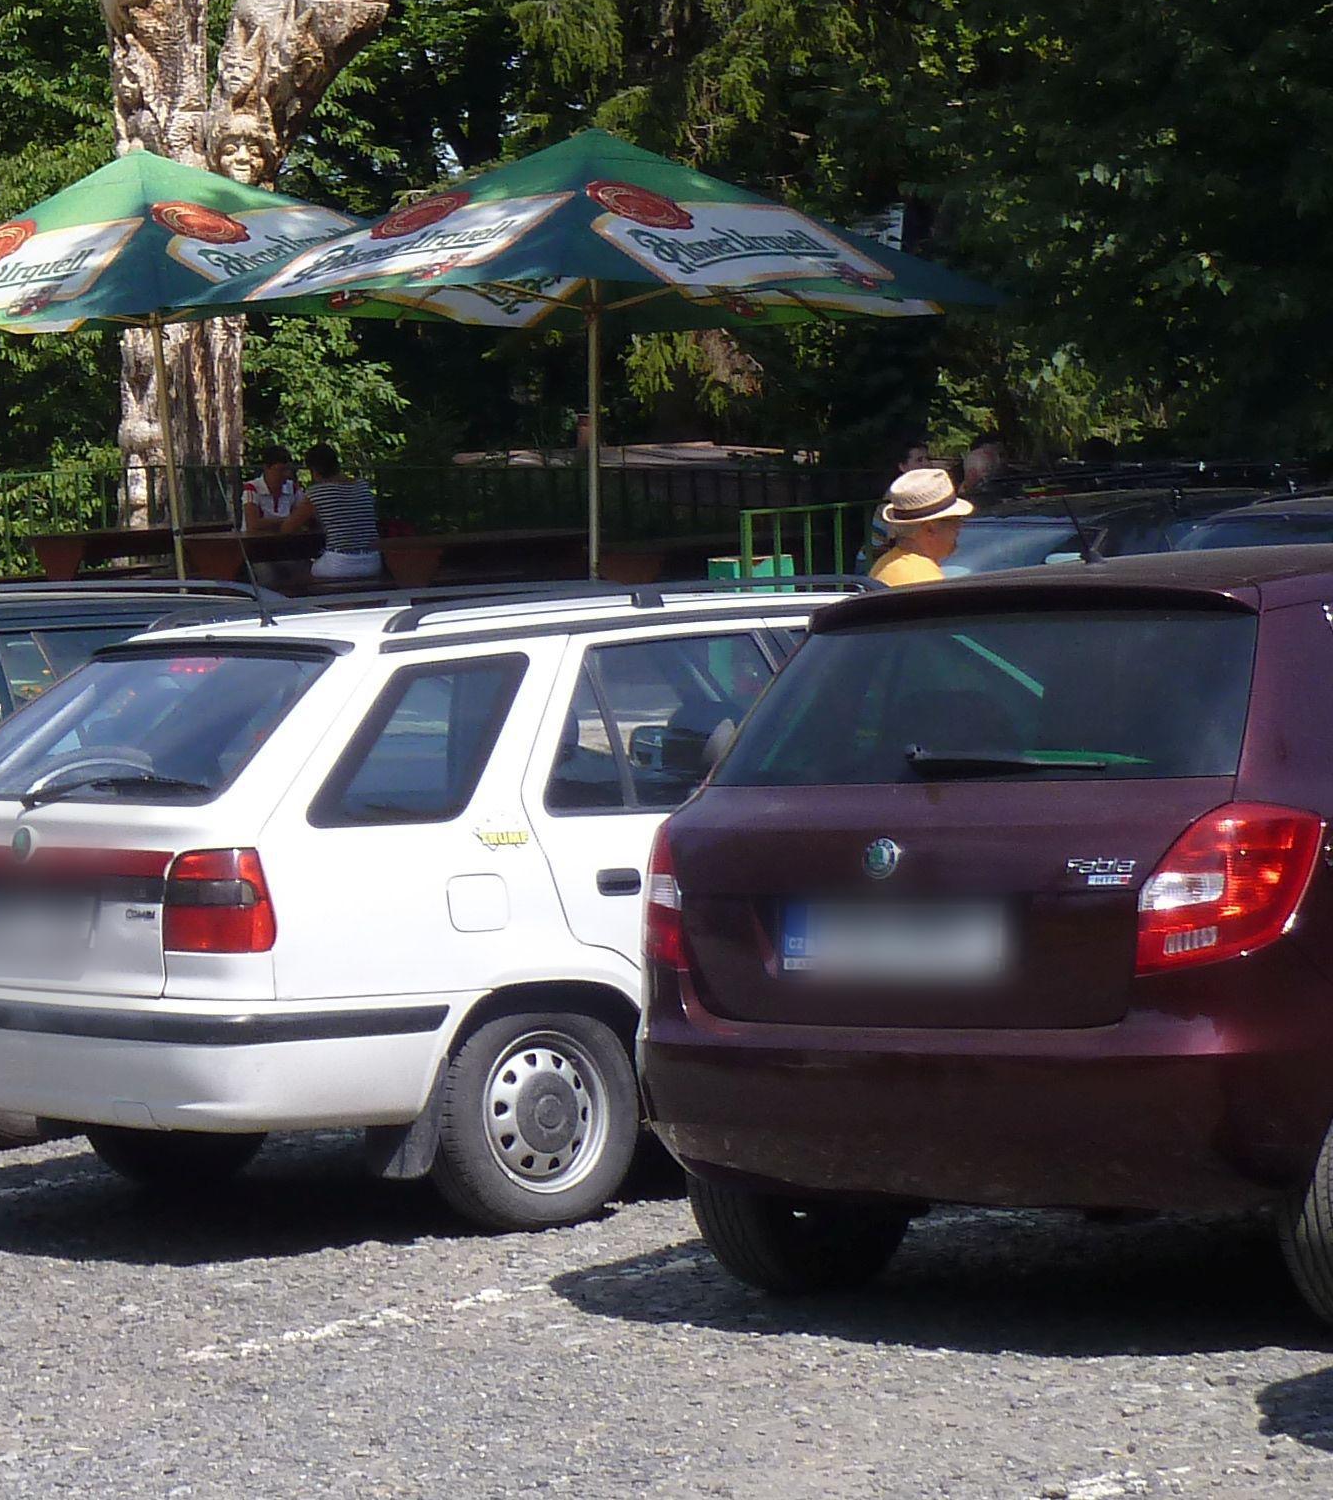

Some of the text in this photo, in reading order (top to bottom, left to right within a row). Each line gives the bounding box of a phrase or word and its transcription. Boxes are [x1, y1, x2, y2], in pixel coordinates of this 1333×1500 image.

[627, 226, 831, 274] Pilsner Urquell
[1066, 857, 1136, 874] Fabia
[788, 936, 804, 949] CZ
